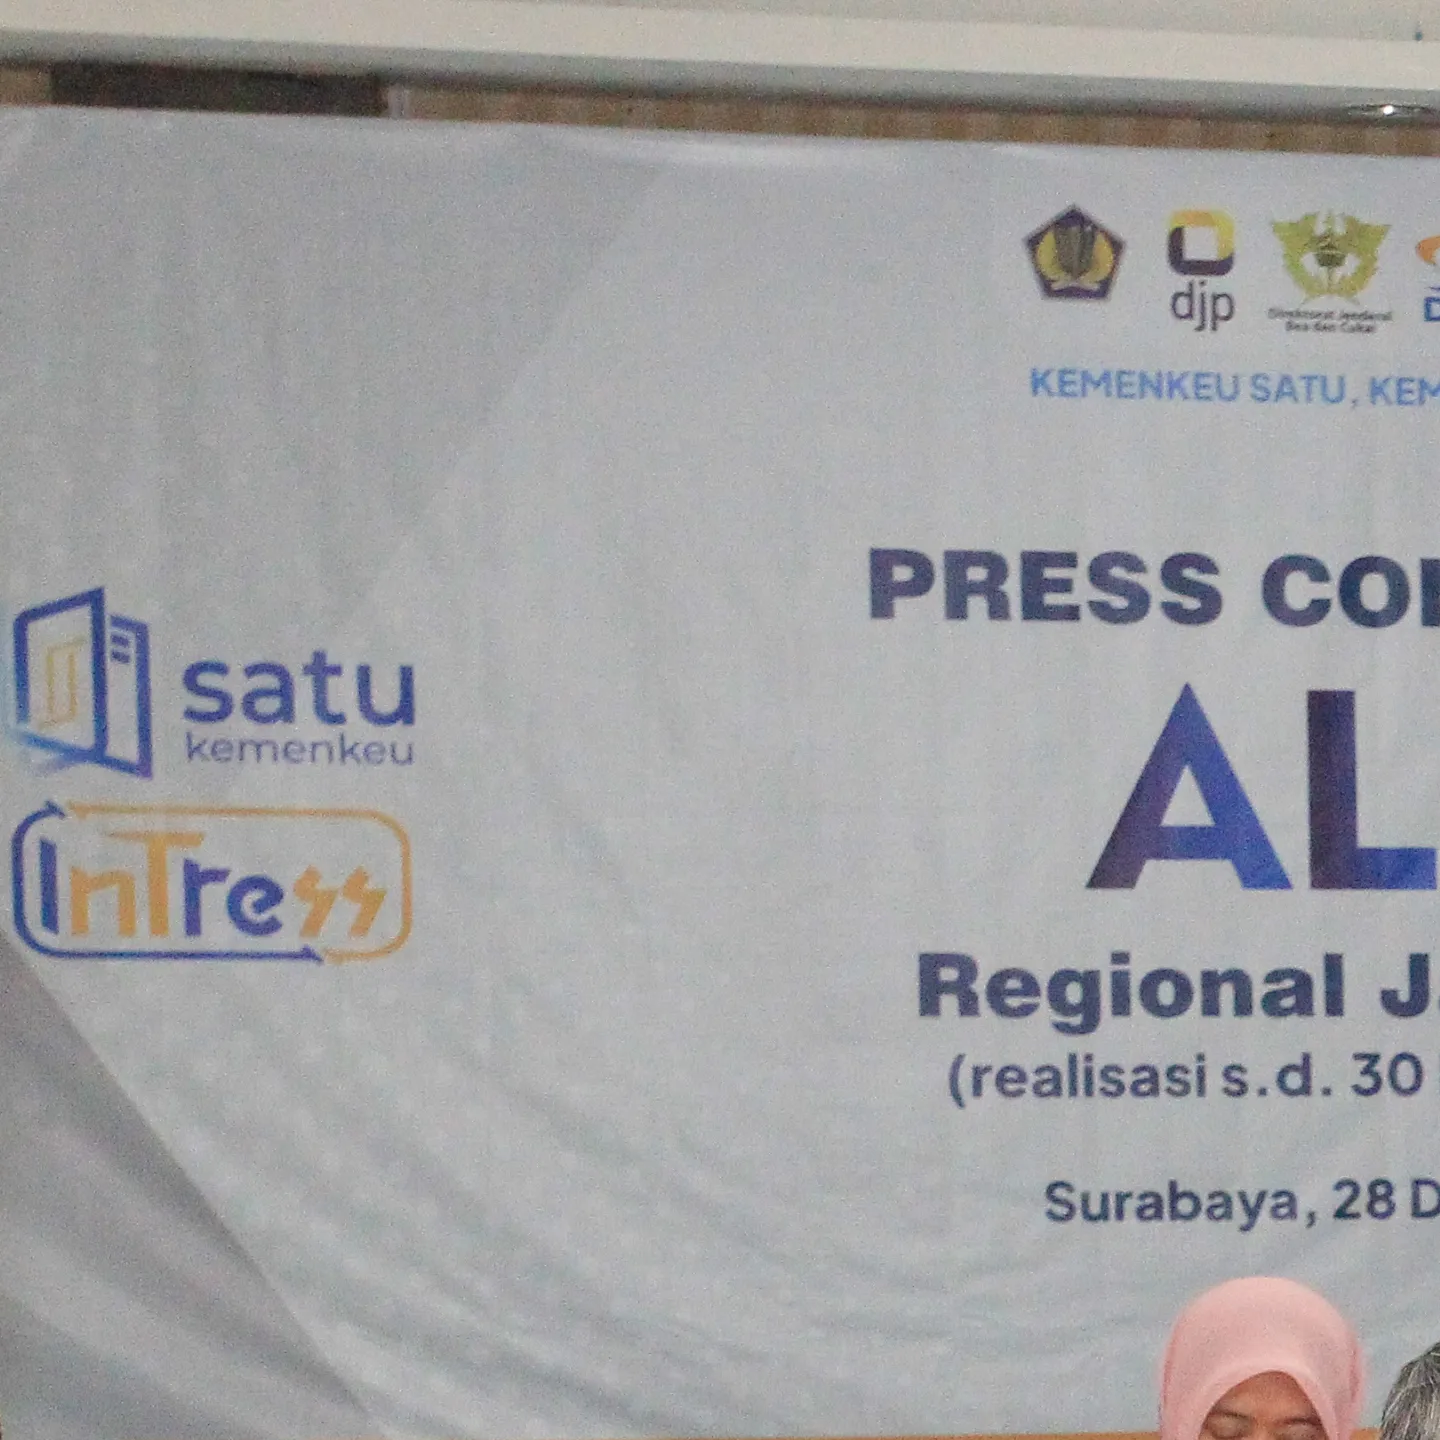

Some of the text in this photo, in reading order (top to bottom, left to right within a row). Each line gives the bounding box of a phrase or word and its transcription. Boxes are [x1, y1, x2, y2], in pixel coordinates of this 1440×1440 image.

[1170, 281, 1235, 332] djp
[1030, 367, 1240, 402] KEMENKEU
[869, 548, 1222, 626] PRESS
[182, 651, 415, 726] satu
[184, 732, 414, 766] kemenkeu
[918, 951, 1344, 1036] Regional
[949, 1053, 1206, 1108] (realisasi
[1222, 1052, 1332, 1098] s.d.
[1352, 1051, 1424, 1097] 30
[1045, 1180, 1316, 1233] Surabaya,
[1333, 1178, 1396, 1220] 28
